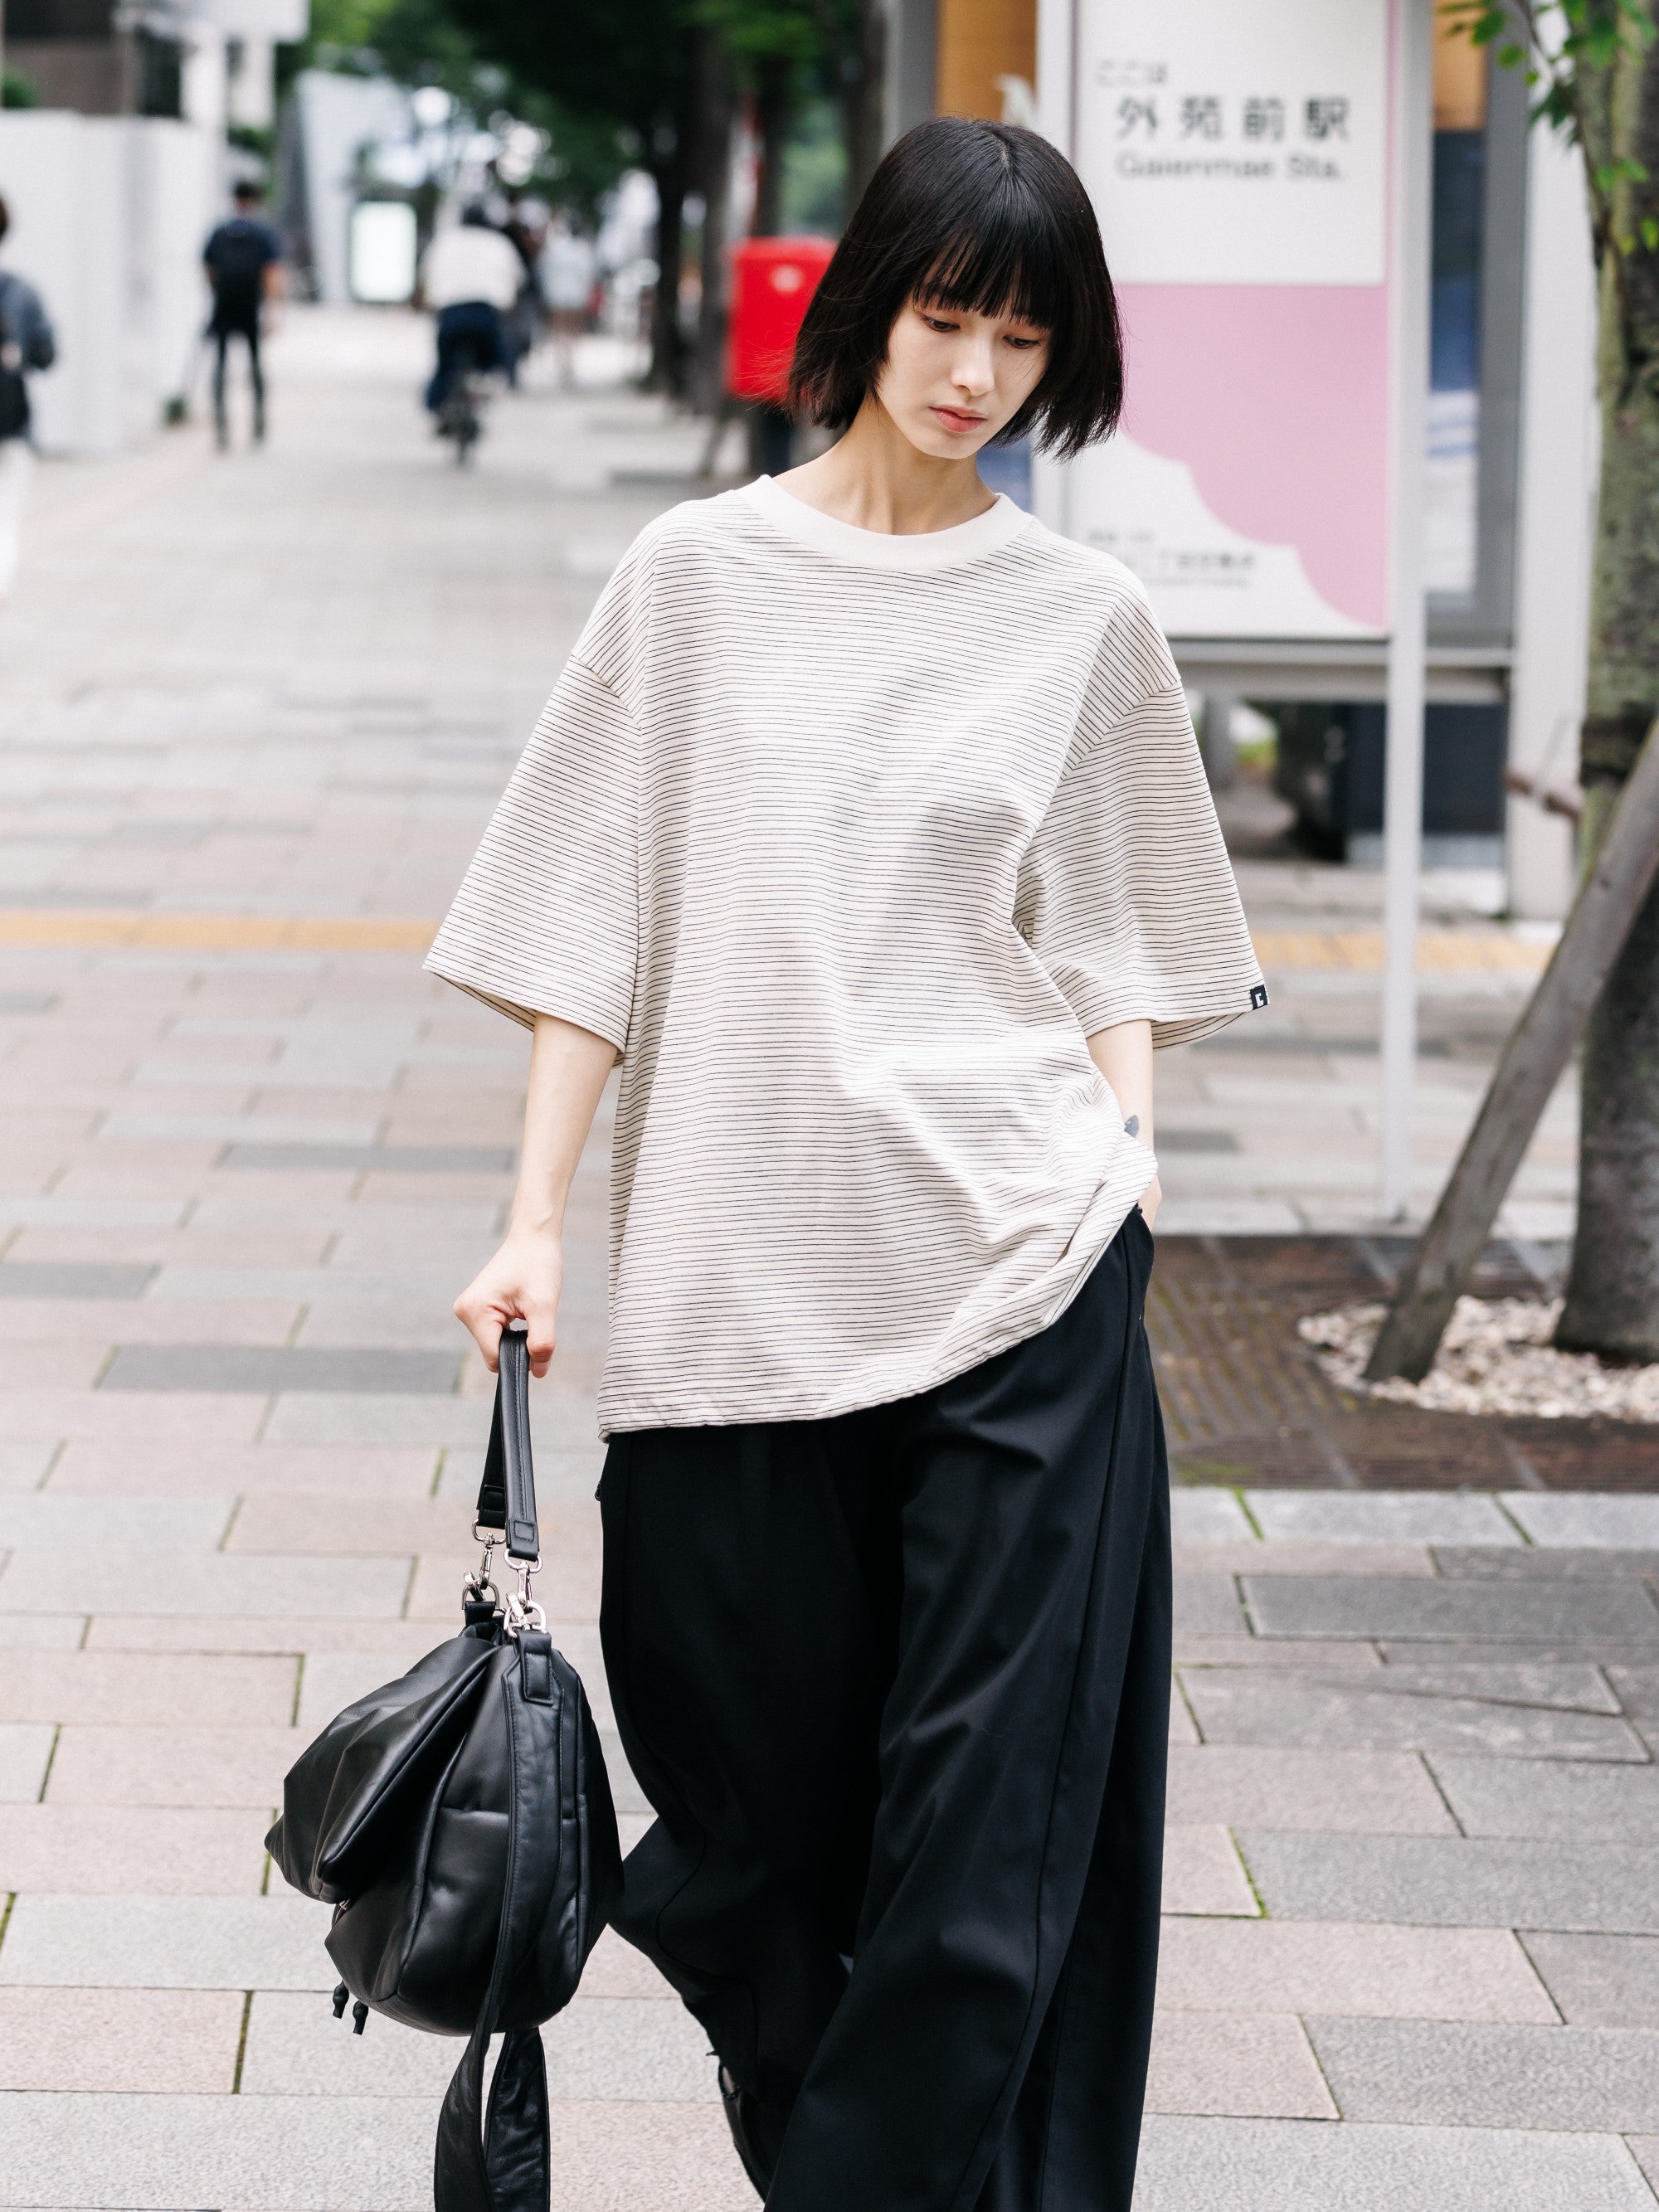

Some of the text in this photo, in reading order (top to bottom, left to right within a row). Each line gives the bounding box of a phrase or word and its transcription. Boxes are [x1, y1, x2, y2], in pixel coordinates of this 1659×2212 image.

[1117, 95, 1350, 142] 外苑前駅
[1116, 150, 1275, 177] Gaienmae
